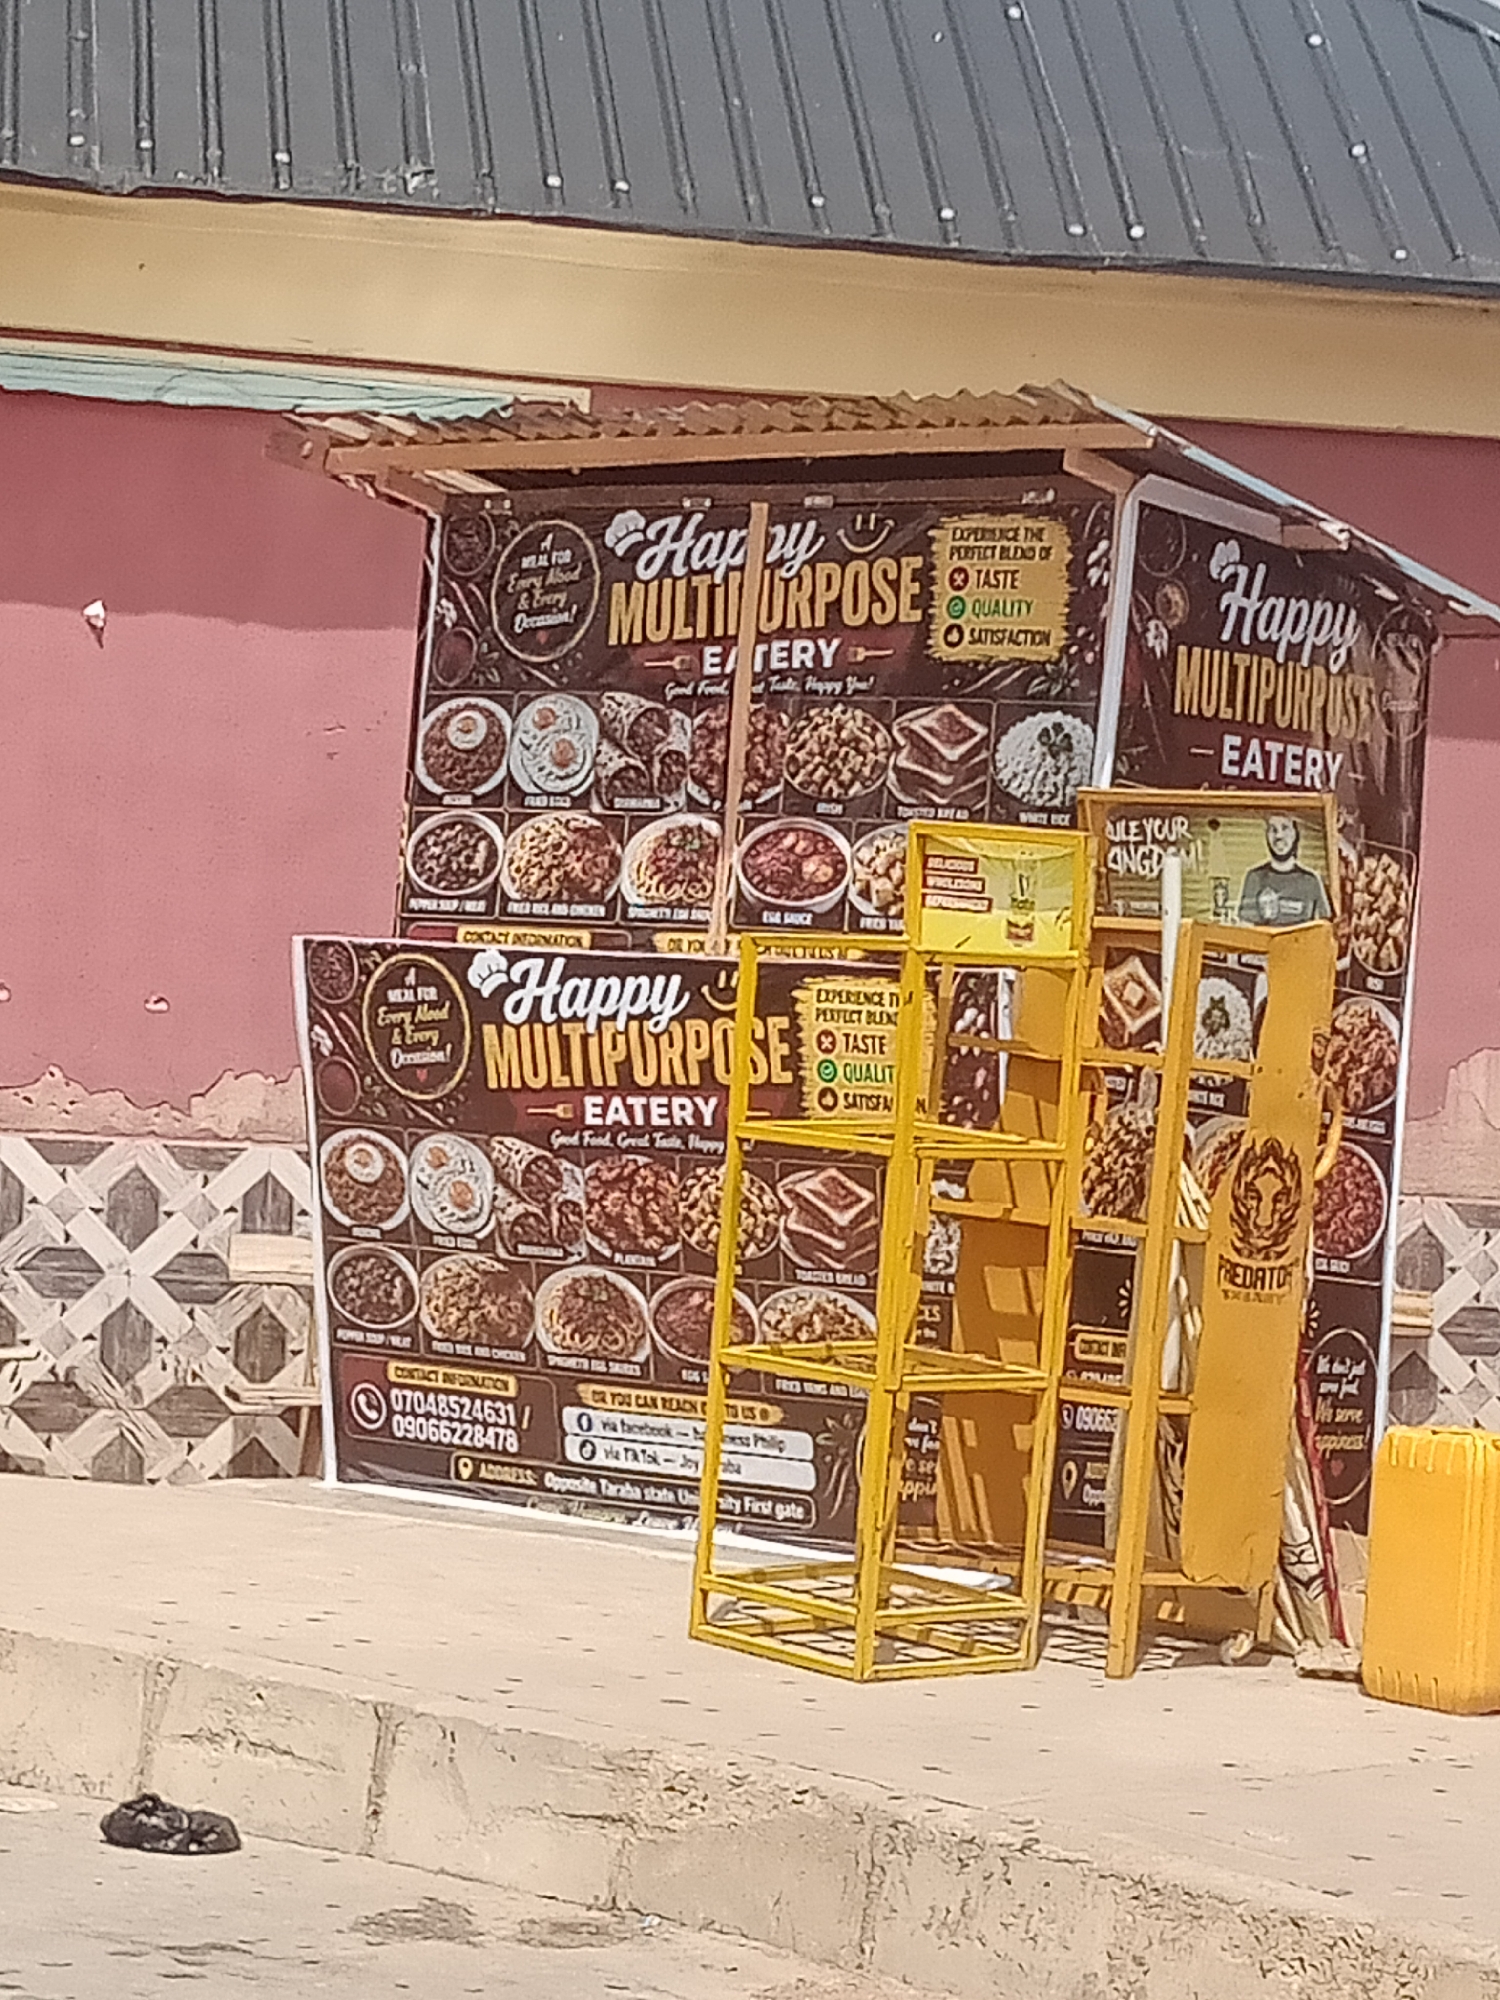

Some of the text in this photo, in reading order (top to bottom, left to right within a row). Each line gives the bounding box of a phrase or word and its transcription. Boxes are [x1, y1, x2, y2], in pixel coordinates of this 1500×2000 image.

[952, 527, 1046, 542] EXPERIENCE THE
[551, 548, 572, 565] FOR
[636, 512, 825, 584] Hapy
[949, 545, 1053, 561] PERFECT BLEND OF
[976, 569, 1020, 590] TASTE
[972, 598, 1034, 618] QUALITY
[1220, 562, 1361, 673] Happy
[968, 627, 1052, 647] SATISFACTION
[664, 680, 693, 700] Good
[805, 675, 842, 695] Happy
[1221, 733, 1343, 791] EATERY
[1142, 815, 1193, 846] YOUR
[464, 931, 583, 949] CONTACT INFORMATION
[417, 986, 438, 1001] FOR
[503, 957, 690, 1034] Happy
[816, 989, 886, 1007] EXPERIENCE
[815, 1008, 862, 1024] PERFECT
[482, 1016, 793, 1089] MULTIPURPOSE
[842, 1033, 886, 1055] TASTE
[843, 1063, 895, 1084] QUALIT
[583, 1095, 717, 1126] EATERY
[550, 1130, 580, 1151] Good
[616, 1131, 650, 1150] Great
[687, 1133, 725, 1155] Happy
[395, 1366, 509, 1392] CONTACT INFORMATION
[390, 1387, 516, 1428] 07048524631
[610, 1392, 632, 1408] YOU
[635, 1394, 658, 1411] CAN
[660, 1396, 698, 1415] REACH
[392, 1413, 519, 1453] 09066228478
[602, 1418, 617, 1433] via
[544, 1471, 598, 1495] Opposite
[599, 1478, 643, 1500] Taraba
[743, 1495, 773, 1514] First
[775, 1502, 805, 1521] gate
